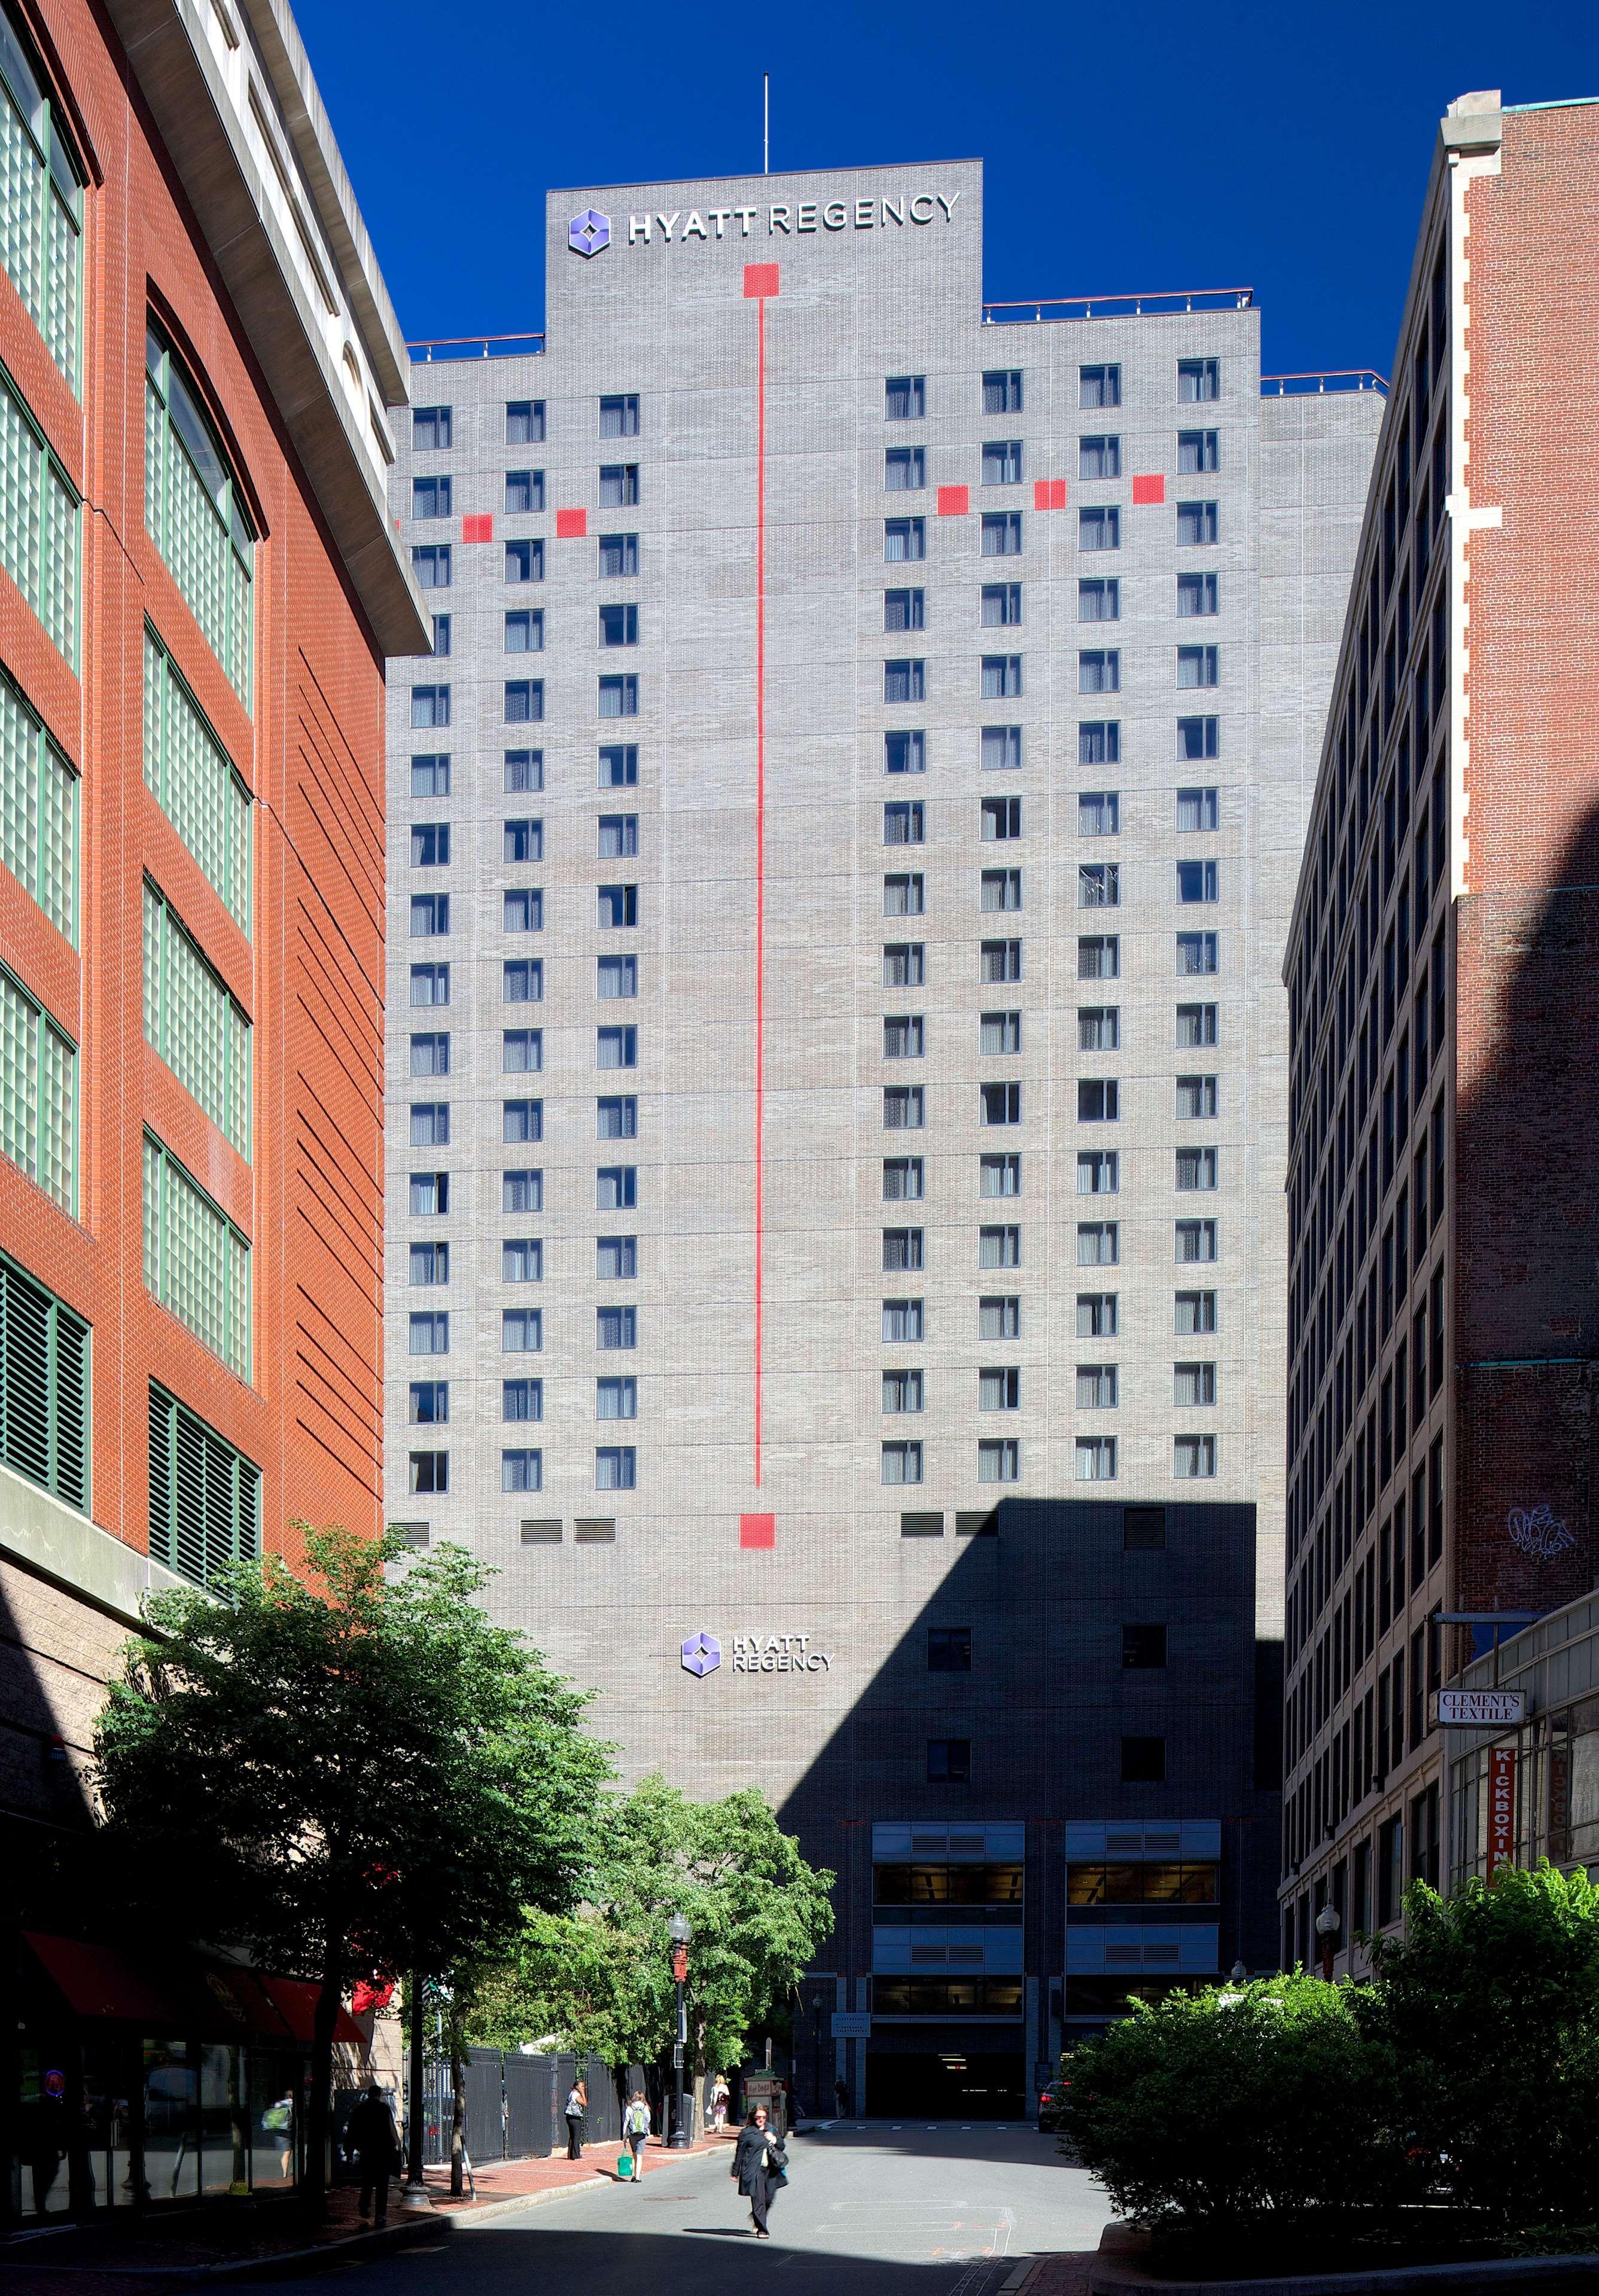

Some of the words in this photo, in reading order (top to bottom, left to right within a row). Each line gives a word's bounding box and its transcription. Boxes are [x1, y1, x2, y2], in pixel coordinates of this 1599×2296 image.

[629, 206, 757, 243] HYATT
[769, 191, 961, 234] REGENCY
[733, 1635, 811, 1652] HYATT
[733, 1652, 836, 1672] REGENCY
[1443, 1694, 1520, 1707] CLEMENT'S
[1449, 1707, 1513, 1720] TEXTILE
